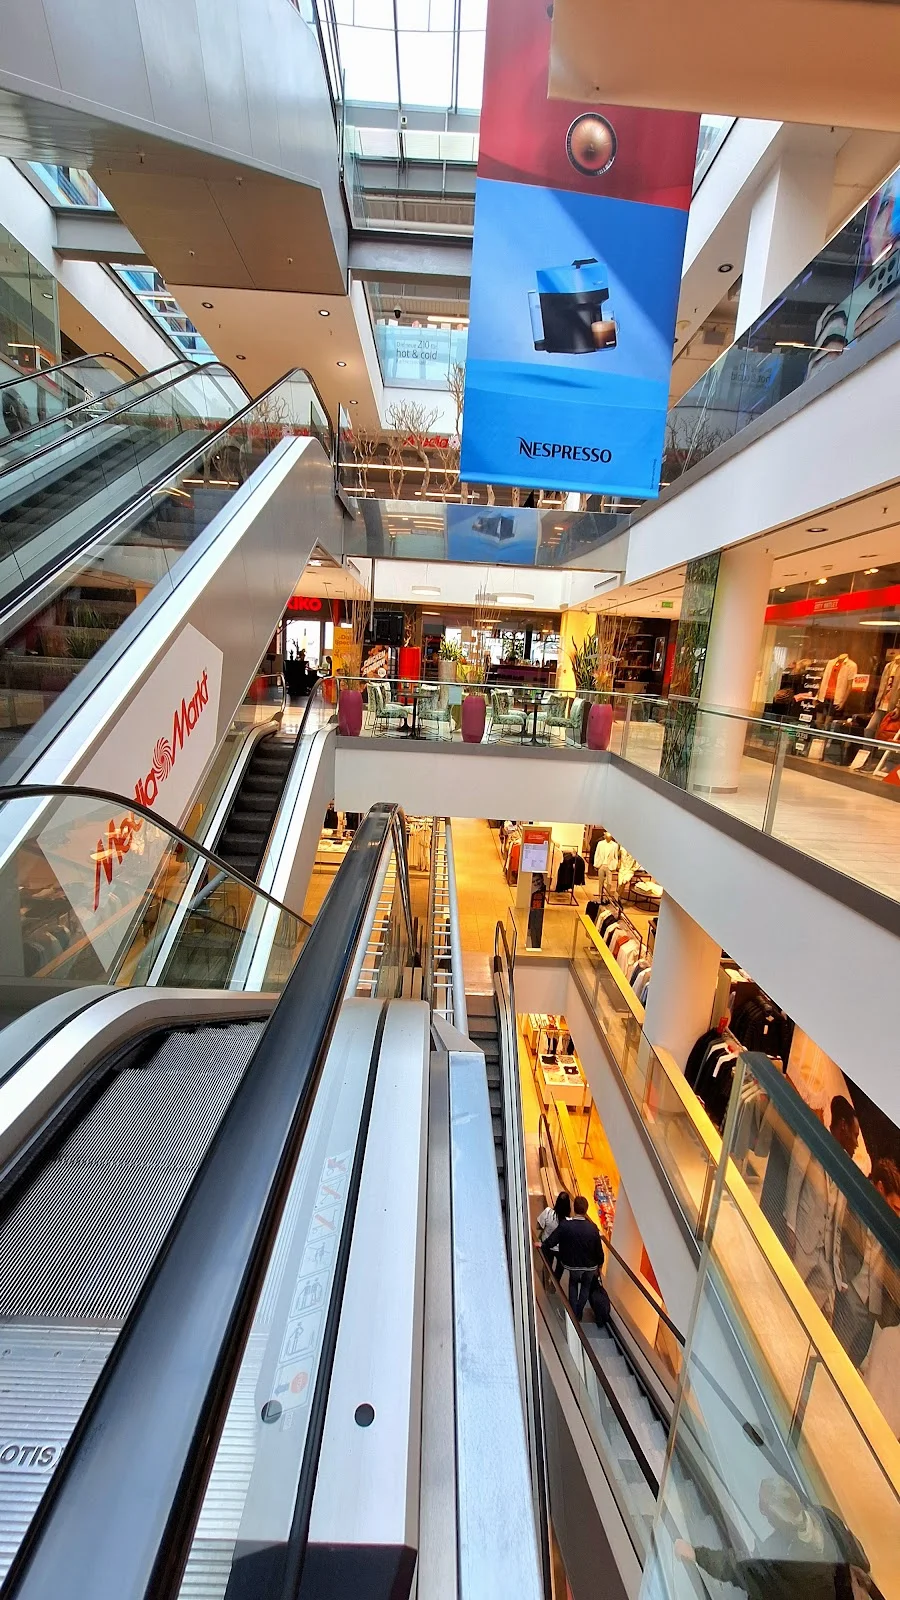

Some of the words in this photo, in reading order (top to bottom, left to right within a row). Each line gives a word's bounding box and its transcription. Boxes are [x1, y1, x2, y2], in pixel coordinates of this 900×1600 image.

[396, 348, 410, 359] hot
[411, 349, 418, 359] &
[420, 350, 438, 360] cold
[516, 436, 612, 463] NESPRESSO
[170, 670, 209, 767] Markt
[0, 1445, 57, 1467] OTIS
